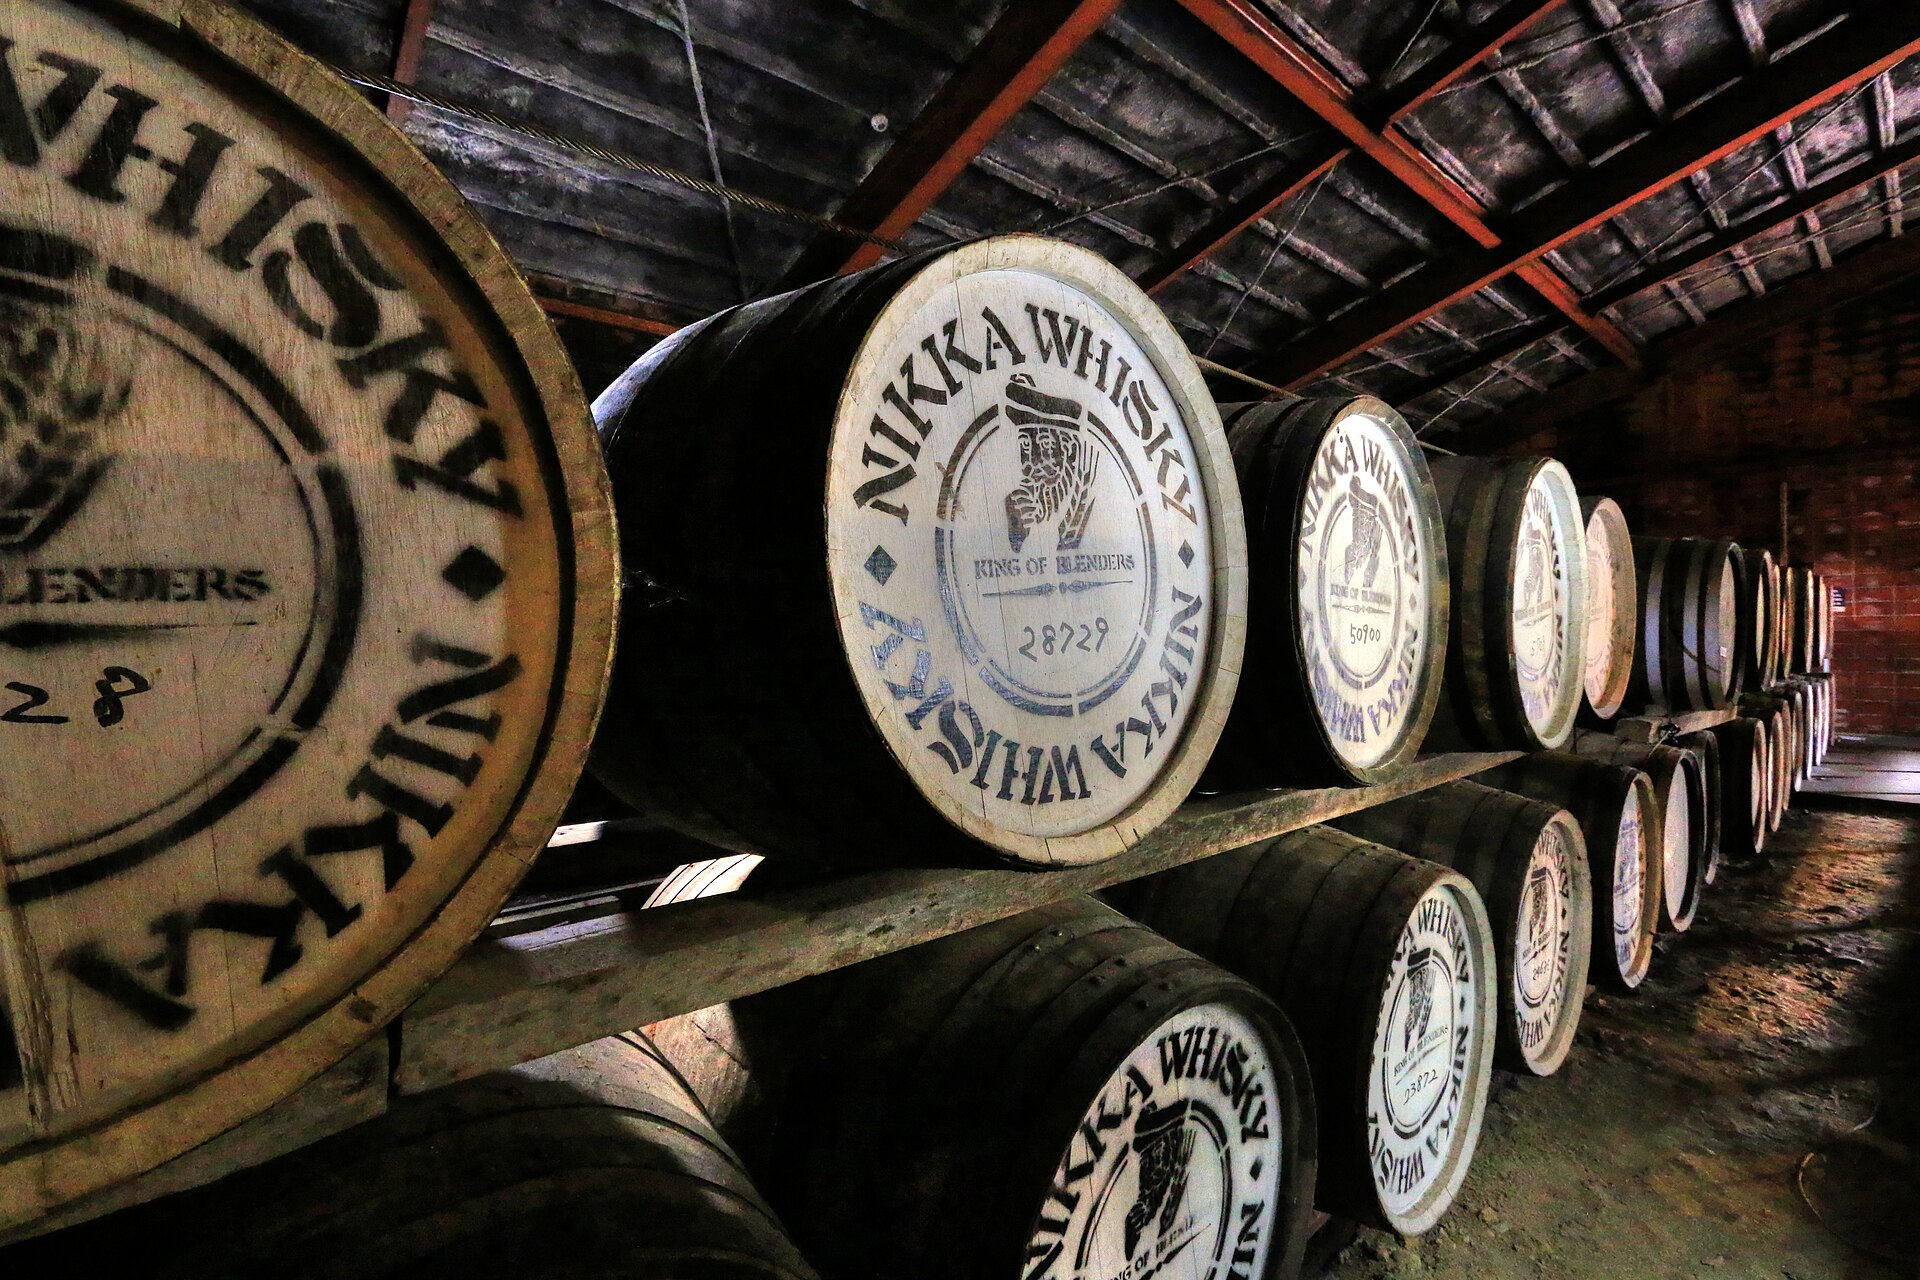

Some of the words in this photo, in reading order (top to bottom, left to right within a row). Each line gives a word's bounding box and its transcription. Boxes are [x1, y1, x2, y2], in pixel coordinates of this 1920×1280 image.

[853, 305, 1026, 526] NIKKA
[1024, 303, 1198, 526] WHISKY
[974, 558, 1021, 580] KING
[1025, 556, 1047, 576] OF
[1055, 553, 1135, 575] BLENDERS
[1301, 432, 1360, 558] NIKKA
[1360, 433, 1420, 584] WHISKY
[1018, 617, 1109, 663] 28729
[1090, 585, 1203, 779] NIKKA
[1350, 623, 1381, 645] 50900
[858, 600, 1092, 806] WHISKY
[52, 632, 523, 1031] NIKKA
[1417, 897, 1470, 983] WHISKY
[1155, 1024, 1270, 1145] WHISKY
